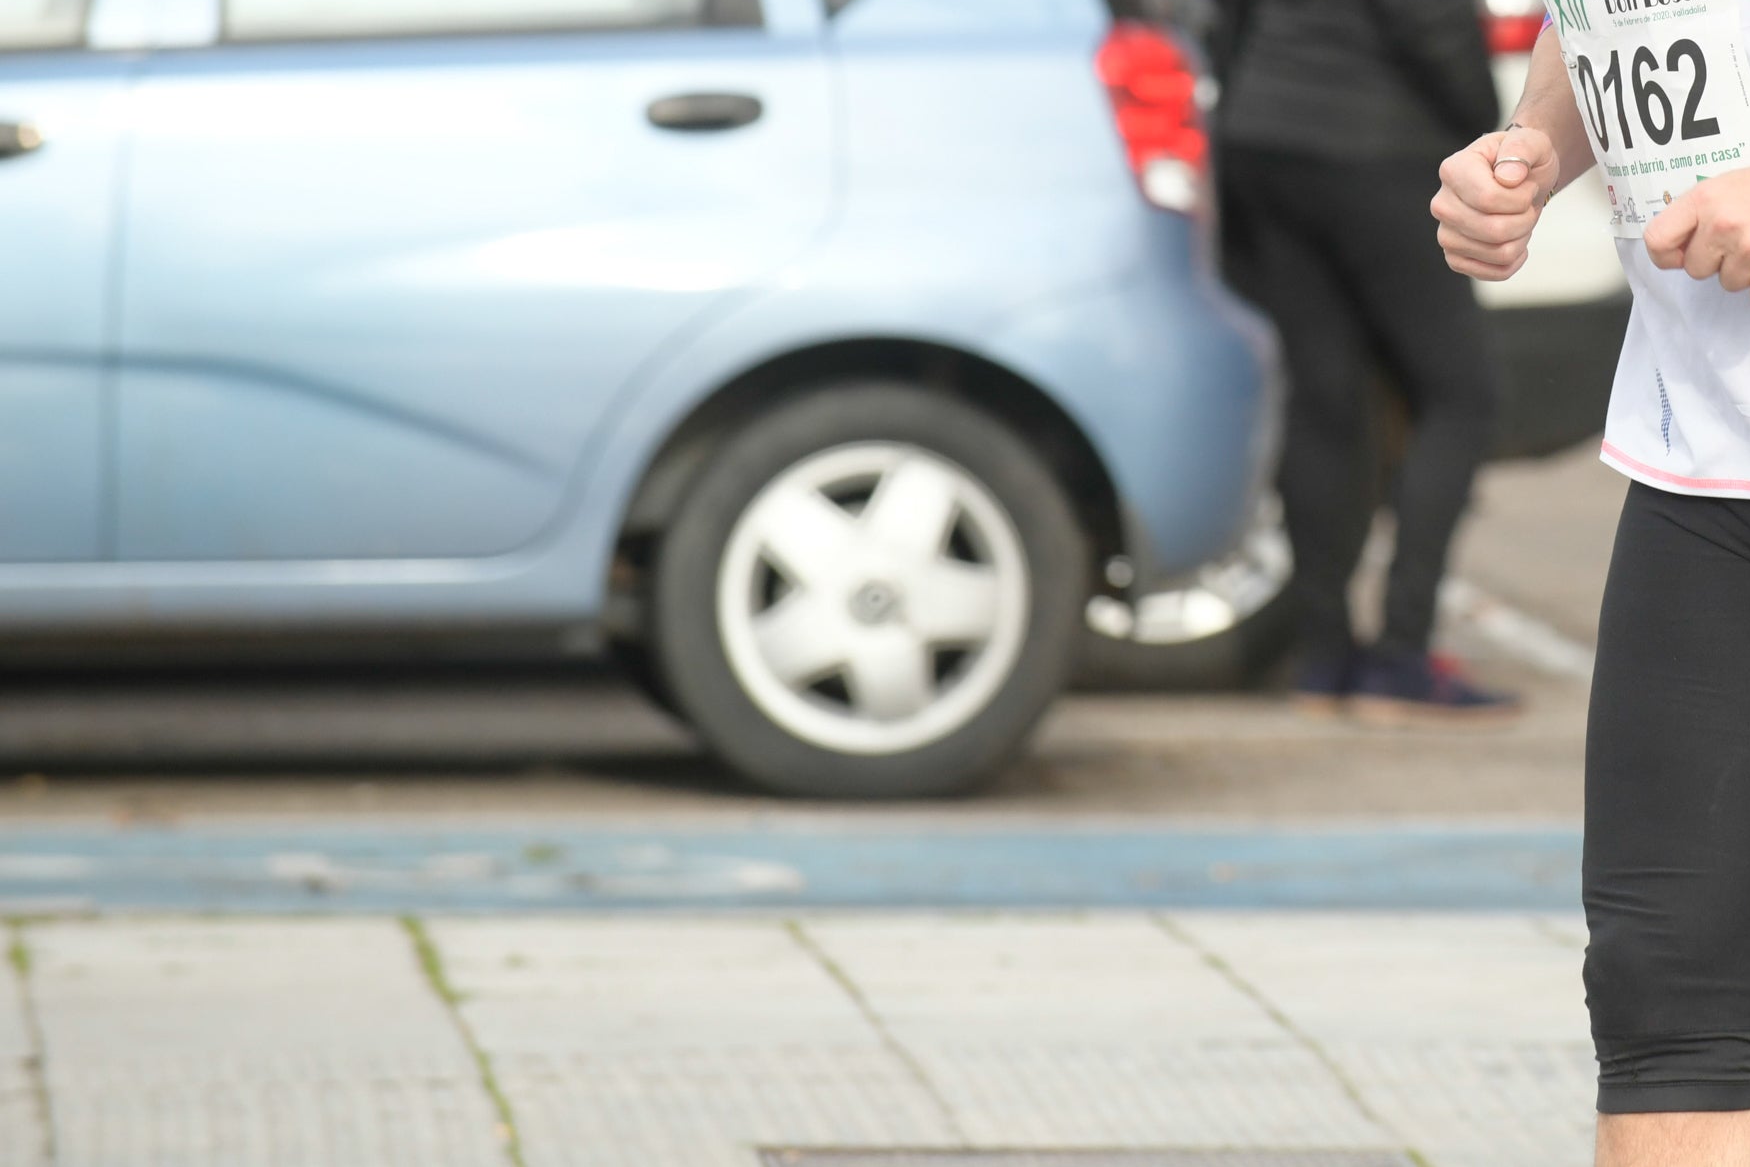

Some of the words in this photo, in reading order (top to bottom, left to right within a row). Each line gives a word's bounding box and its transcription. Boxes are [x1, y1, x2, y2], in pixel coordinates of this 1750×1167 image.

[1673, 4, 1707, 17] Valladolid
[1577, 38, 1721, 152] 0162
[1631, 161, 1638, 176] el
[1639, 158, 1668, 174] barrio,
[1670, 155, 1693, 170] como
[1695, 153, 1708, 165] en
